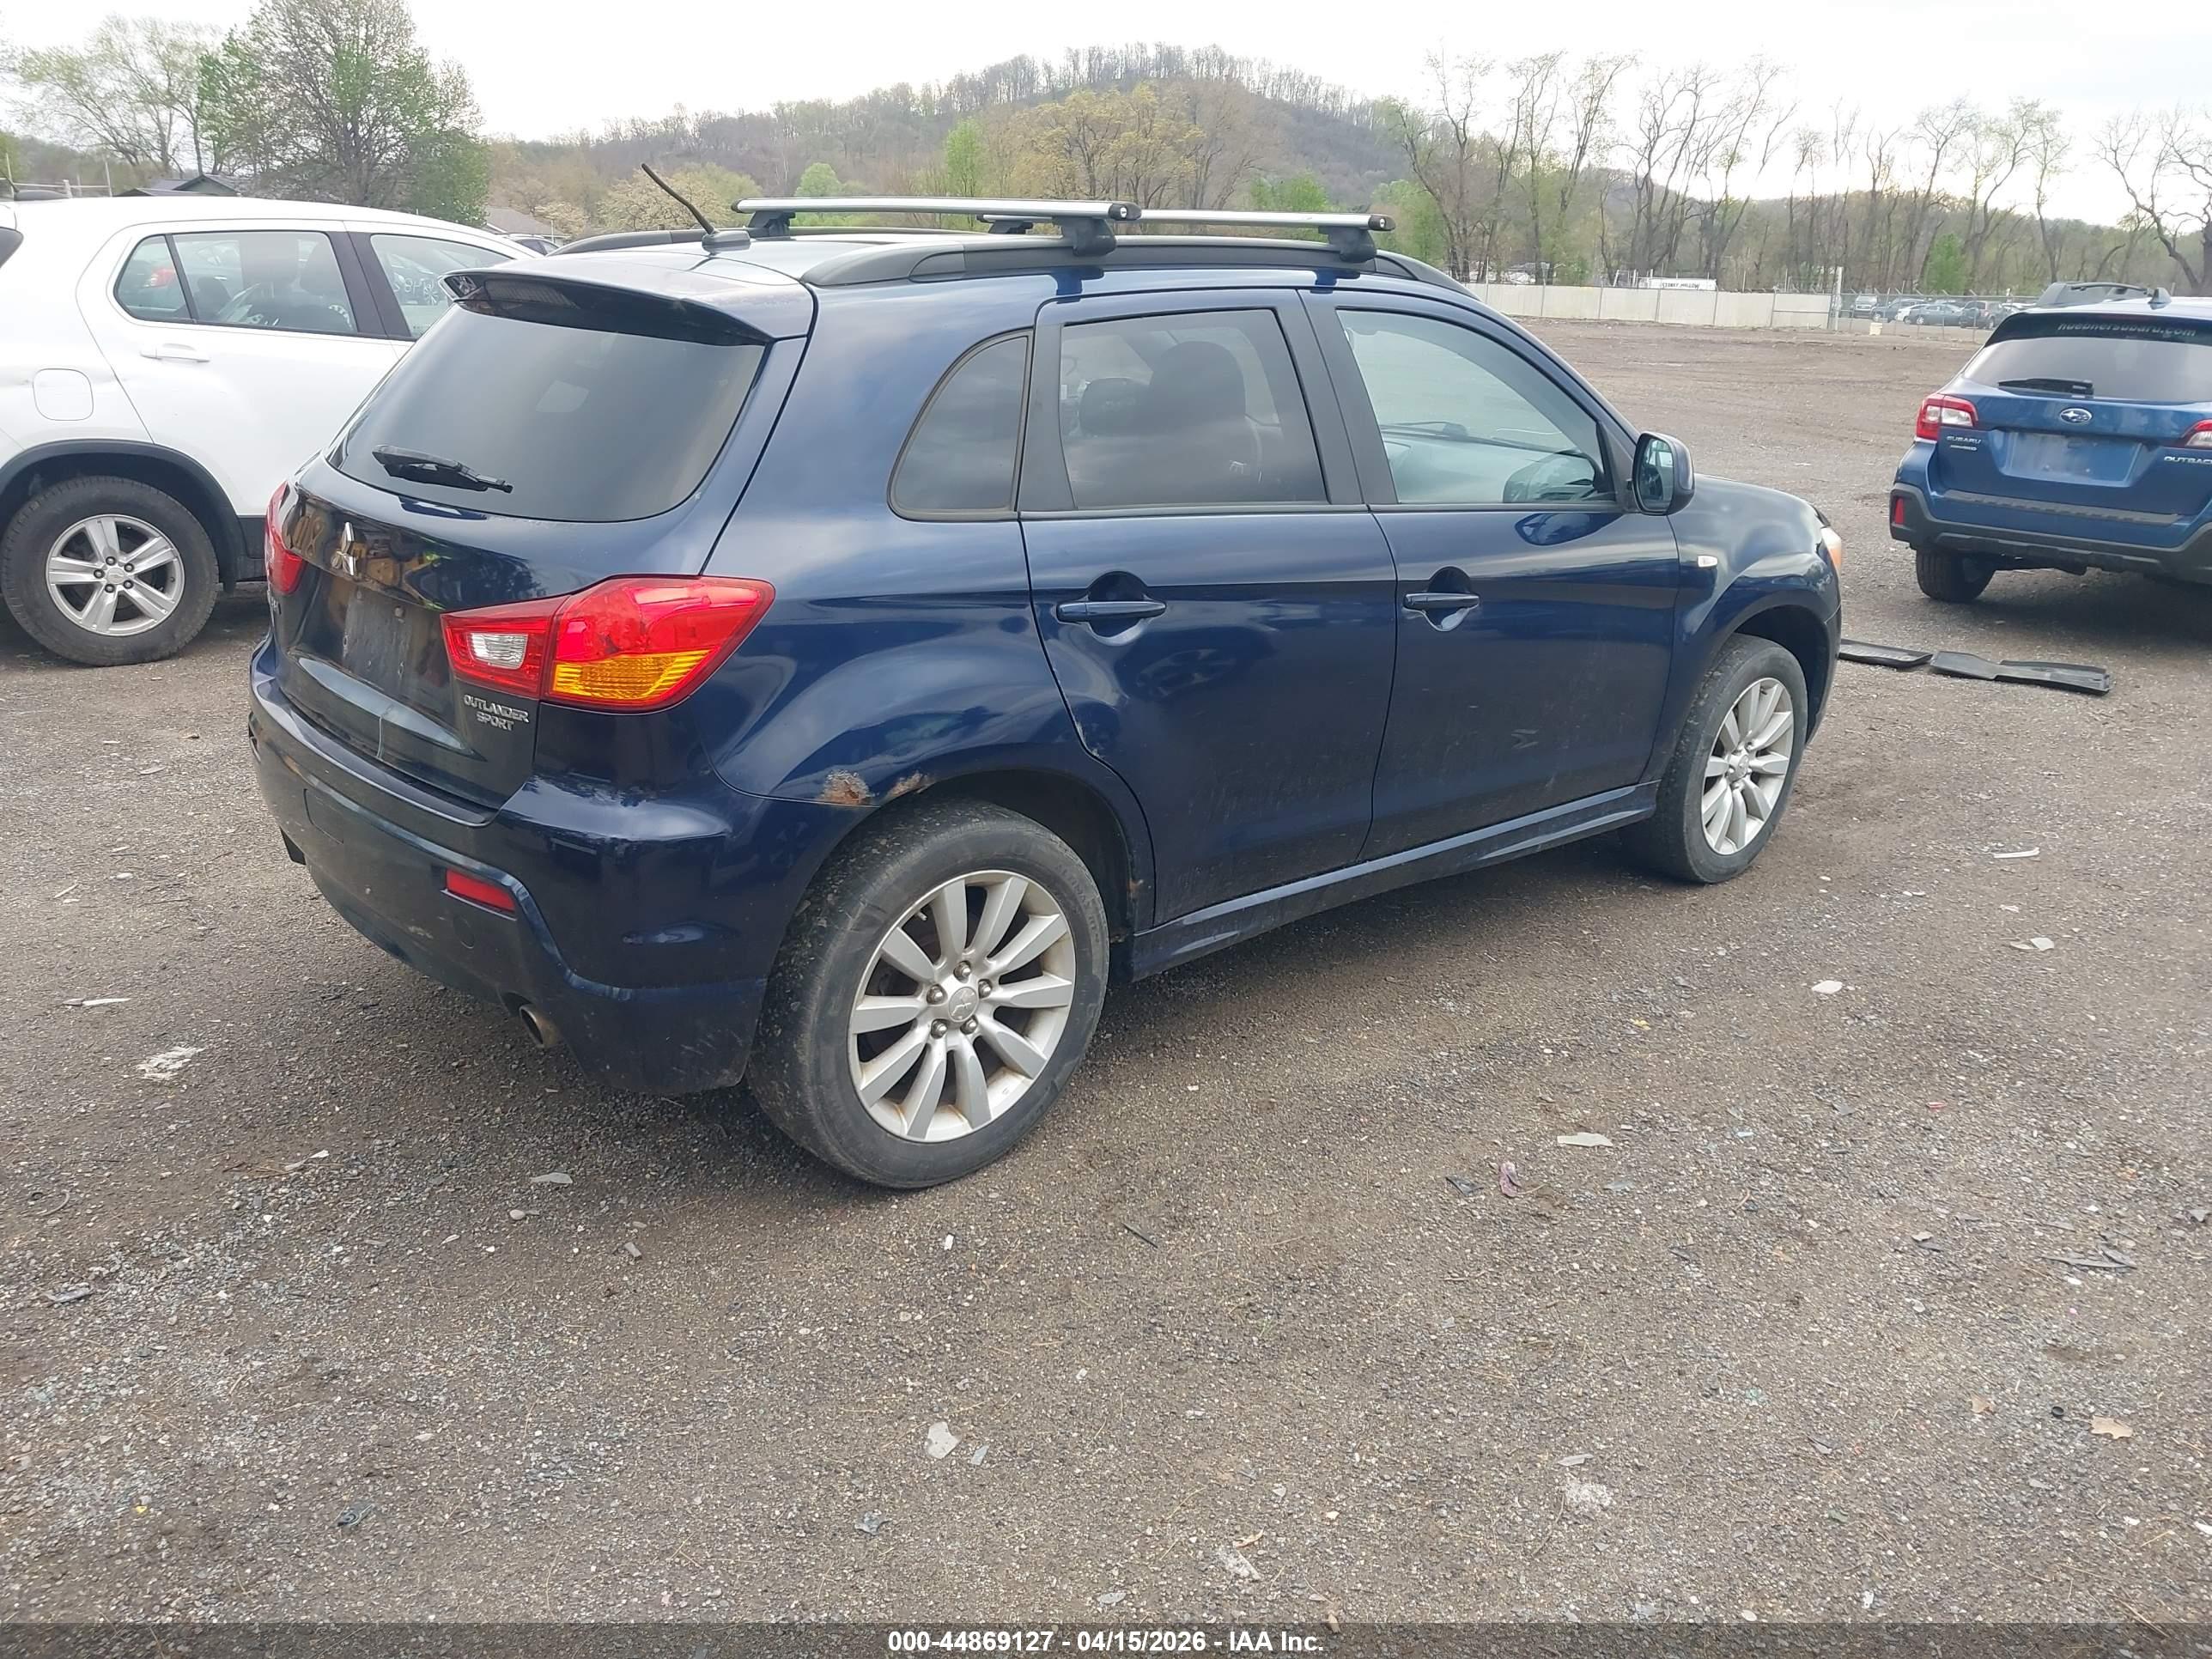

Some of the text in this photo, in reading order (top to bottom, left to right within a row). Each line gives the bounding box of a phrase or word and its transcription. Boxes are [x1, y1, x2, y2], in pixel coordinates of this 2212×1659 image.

[1946, 435, 1982, 444] SUBARU
[463, 694, 530, 723] OUTLANDER
[476, 711, 514, 731] SPORT
